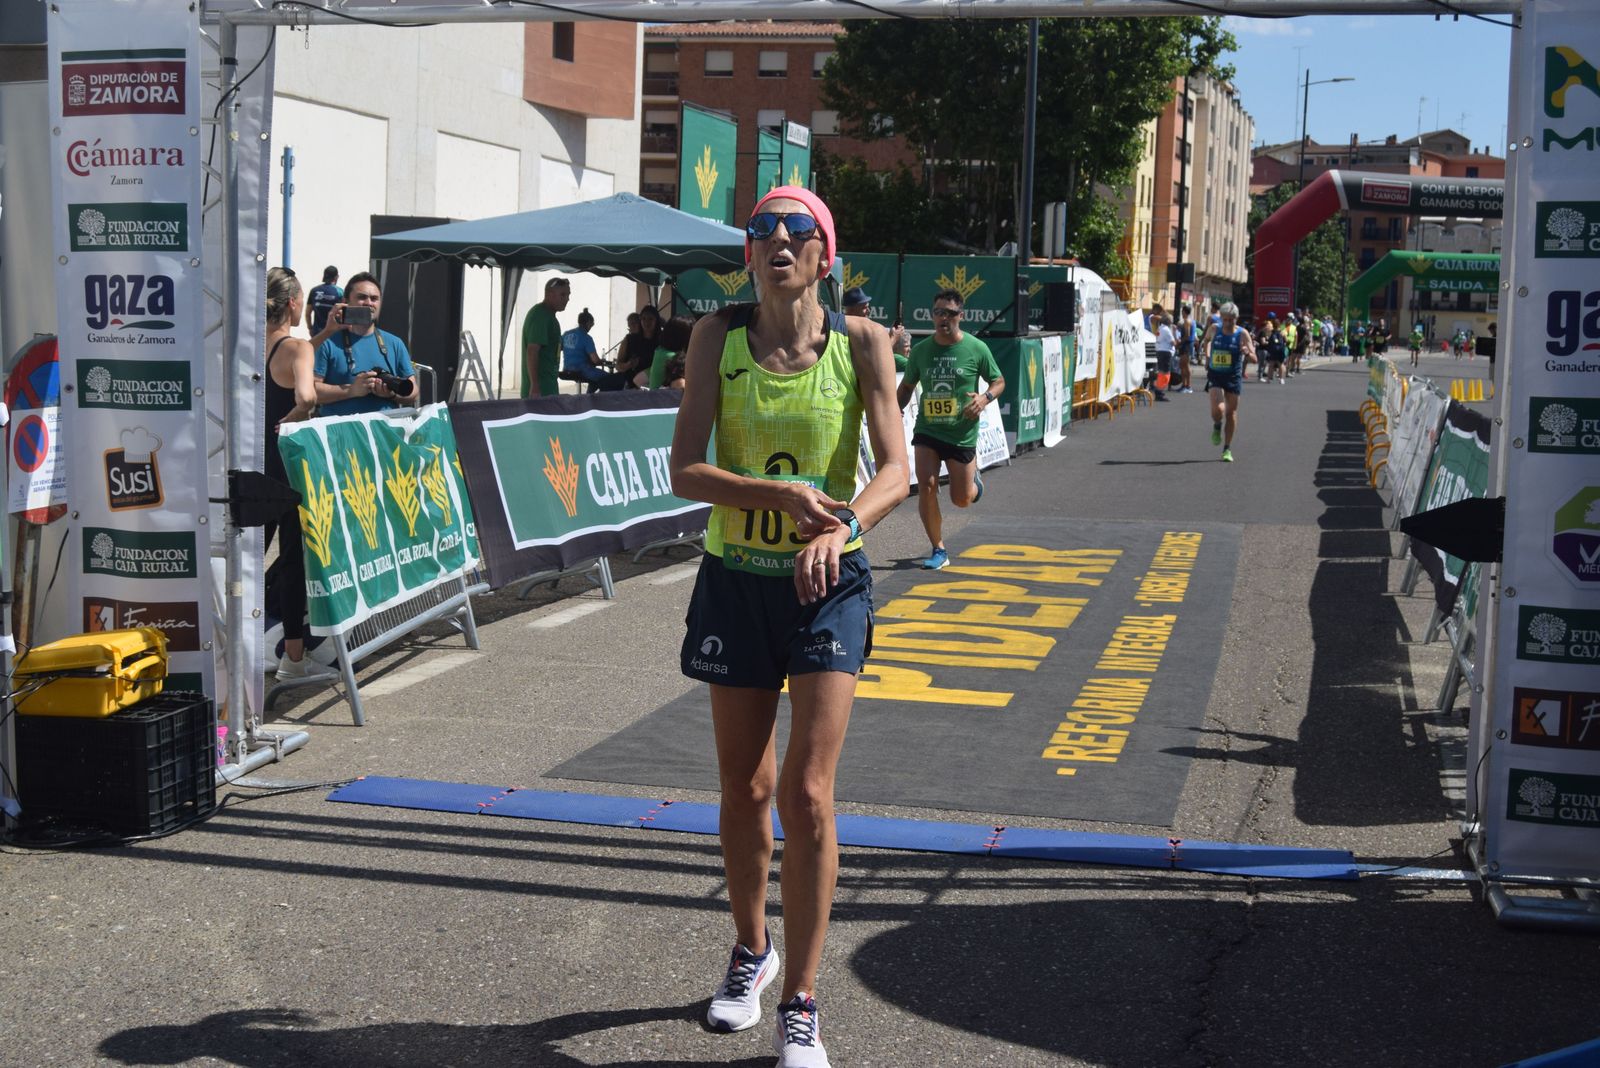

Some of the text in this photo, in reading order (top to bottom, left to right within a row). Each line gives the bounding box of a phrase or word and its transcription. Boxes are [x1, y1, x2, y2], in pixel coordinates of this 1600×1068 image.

[89, 71, 178, 85] DIPUTACIÓN DE
[89, 86, 180, 105] ZAMORA
[110, 175, 144, 185] Zamora
[1421, 183, 1504, 198] CON EL DEPOR
[1420, 197, 1475, 209] GANAMOS
[108, 220, 180, 234] FUNDACION
[108, 233, 180, 246] CAJA RURAL
[1434, 259, 1465, 271] CAJA
[1429, 280, 1484, 290] SALIDA
[84, 274, 175, 330] gaza
[87, 333, 176, 345] Ganaderos de Zamora
[1545, 359, 1600, 373] Ganader
[112, 379, 183, 394] FUNDACION
[112, 391, 184, 405] CAJA RURAL
[927, 400, 953, 414] 195
[110, 464, 154, 496] Susi
[586, 450, 648, 508] CAJA
[115, 547, 188, 561] FUNDACION
[115, 560, 189, 573] CAJA RURAL
[751, 556, 780, 569] CAJA
[123, 607, 197, 630] Fariña
[1094, 614, 1178, 673] INTEGRAL
[1041, 677, 1153, 763] REFORMA
[1559, 793, 1600, 808] FUN
